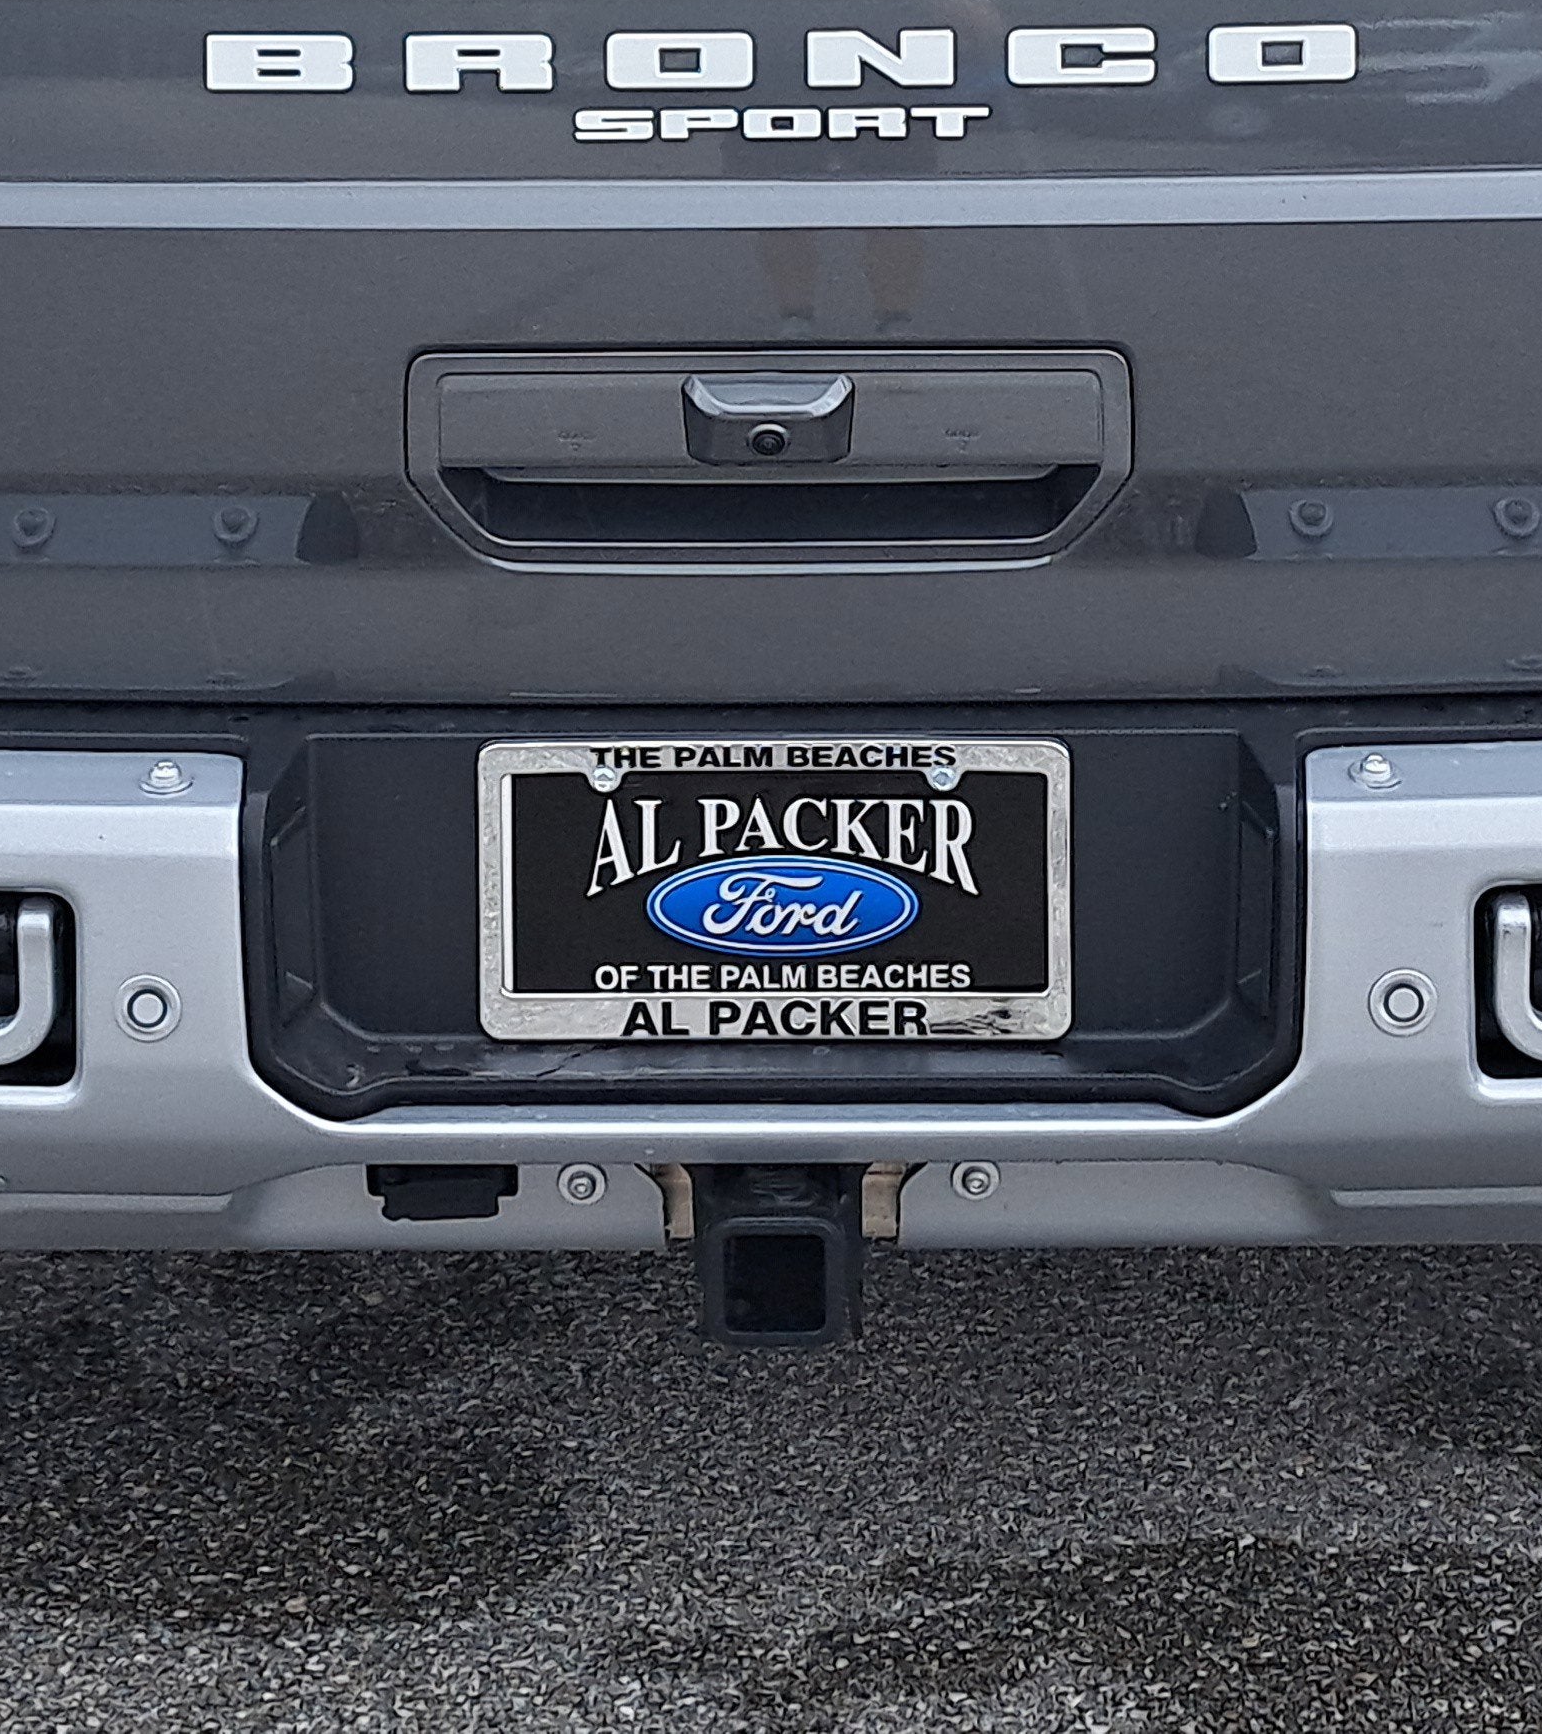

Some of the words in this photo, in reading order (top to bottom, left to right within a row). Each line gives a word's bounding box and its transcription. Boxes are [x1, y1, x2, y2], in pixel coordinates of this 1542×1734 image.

[205, 26, 1357, 91] BRONCO
[574, 106, 989, 140] SPORT
[590, 747, 662, 768] THE
[674, 746, 773, 768] PALM
[786, 746, 957, 767] BEACHES
[586, 798, 681, 897] AL
[695, 797, 979, 896] PACKER
[702, 871, 862, 937] Ford
[594, 965, 641, 991] OF
[646, 965, 711, 991] THE
[720, 964, 807, 990] PALM
[817, 964, 971, 989] BEACHES
[621, 1001, 690, 1037] AL
[708, 999, 929, 1037] PACKER
